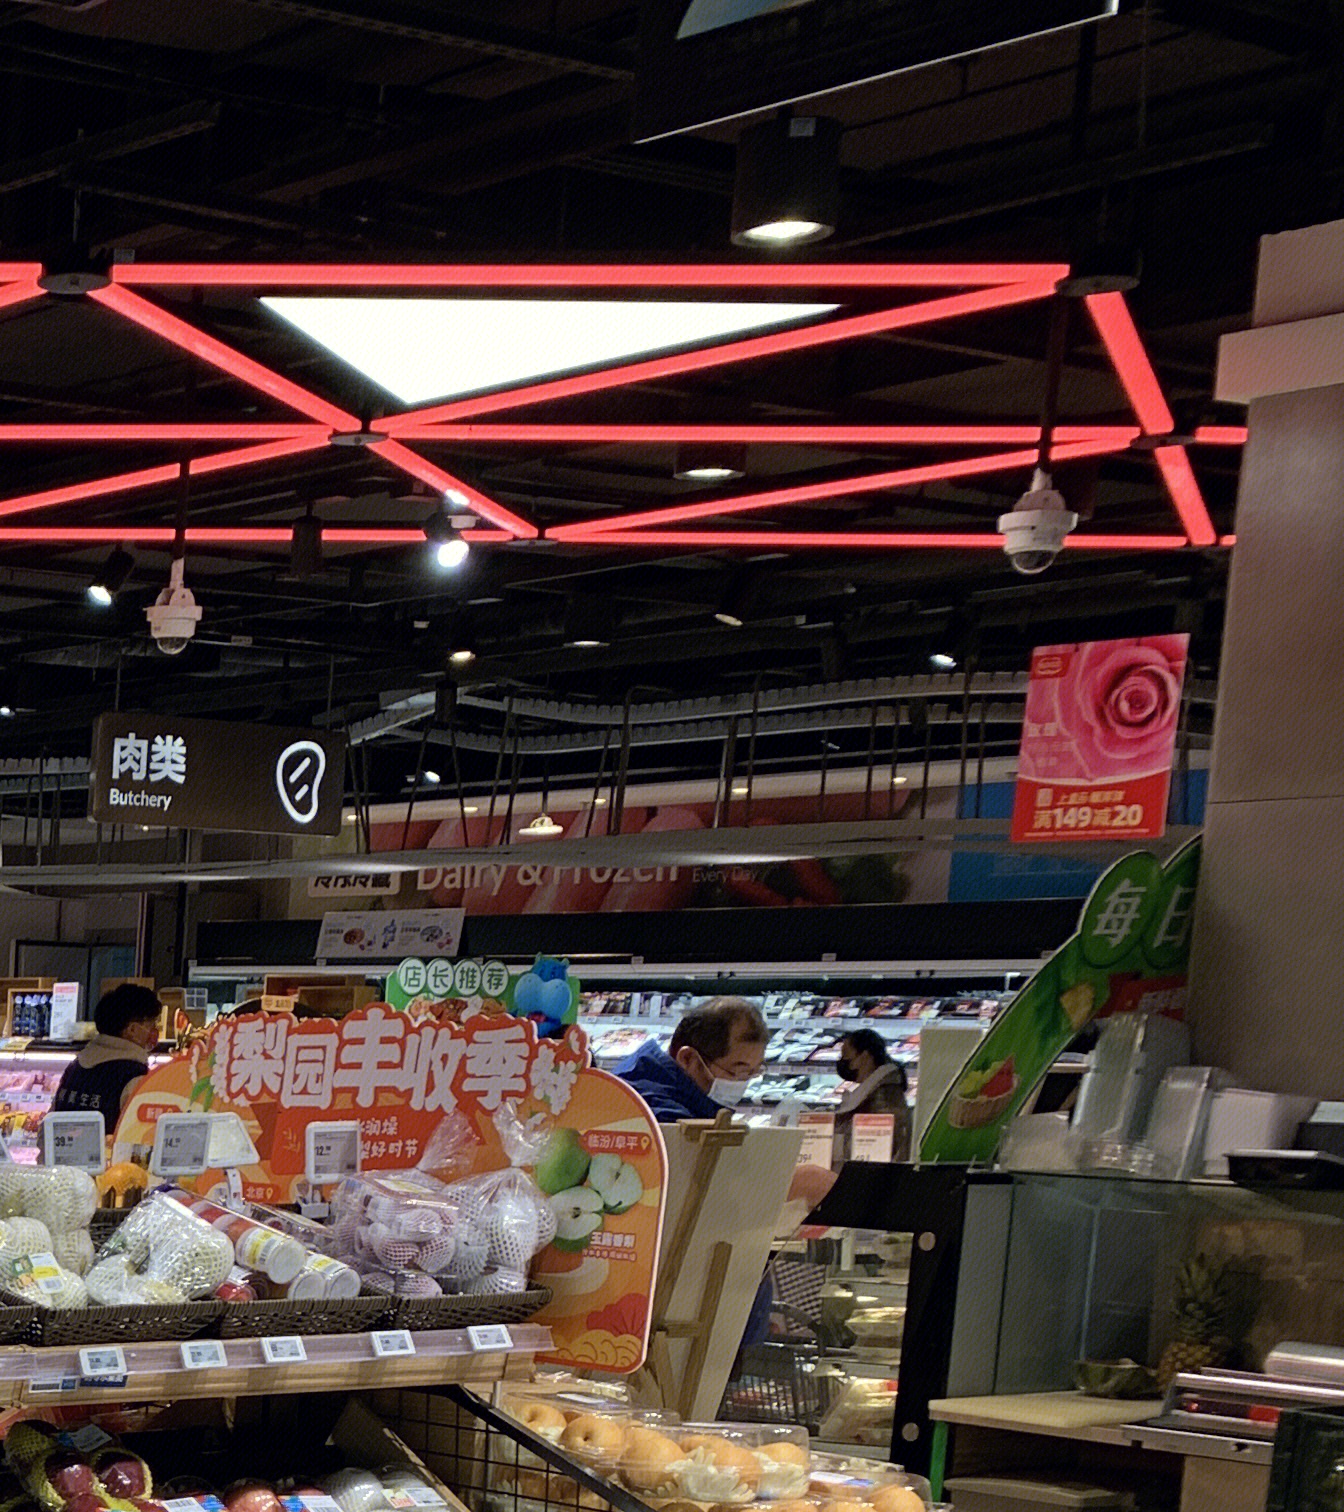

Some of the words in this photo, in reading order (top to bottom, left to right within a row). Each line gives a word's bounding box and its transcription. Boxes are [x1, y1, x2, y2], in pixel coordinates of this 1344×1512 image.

[112, 733, 187, 784] 肉类
[109, 788, 172, 812] Butchery
[402, 962, 509, 992] 店长推荐
[230, 1007, 529, 1110] 梨园丰收季
[246, 1188, 265, 1200] 北京
